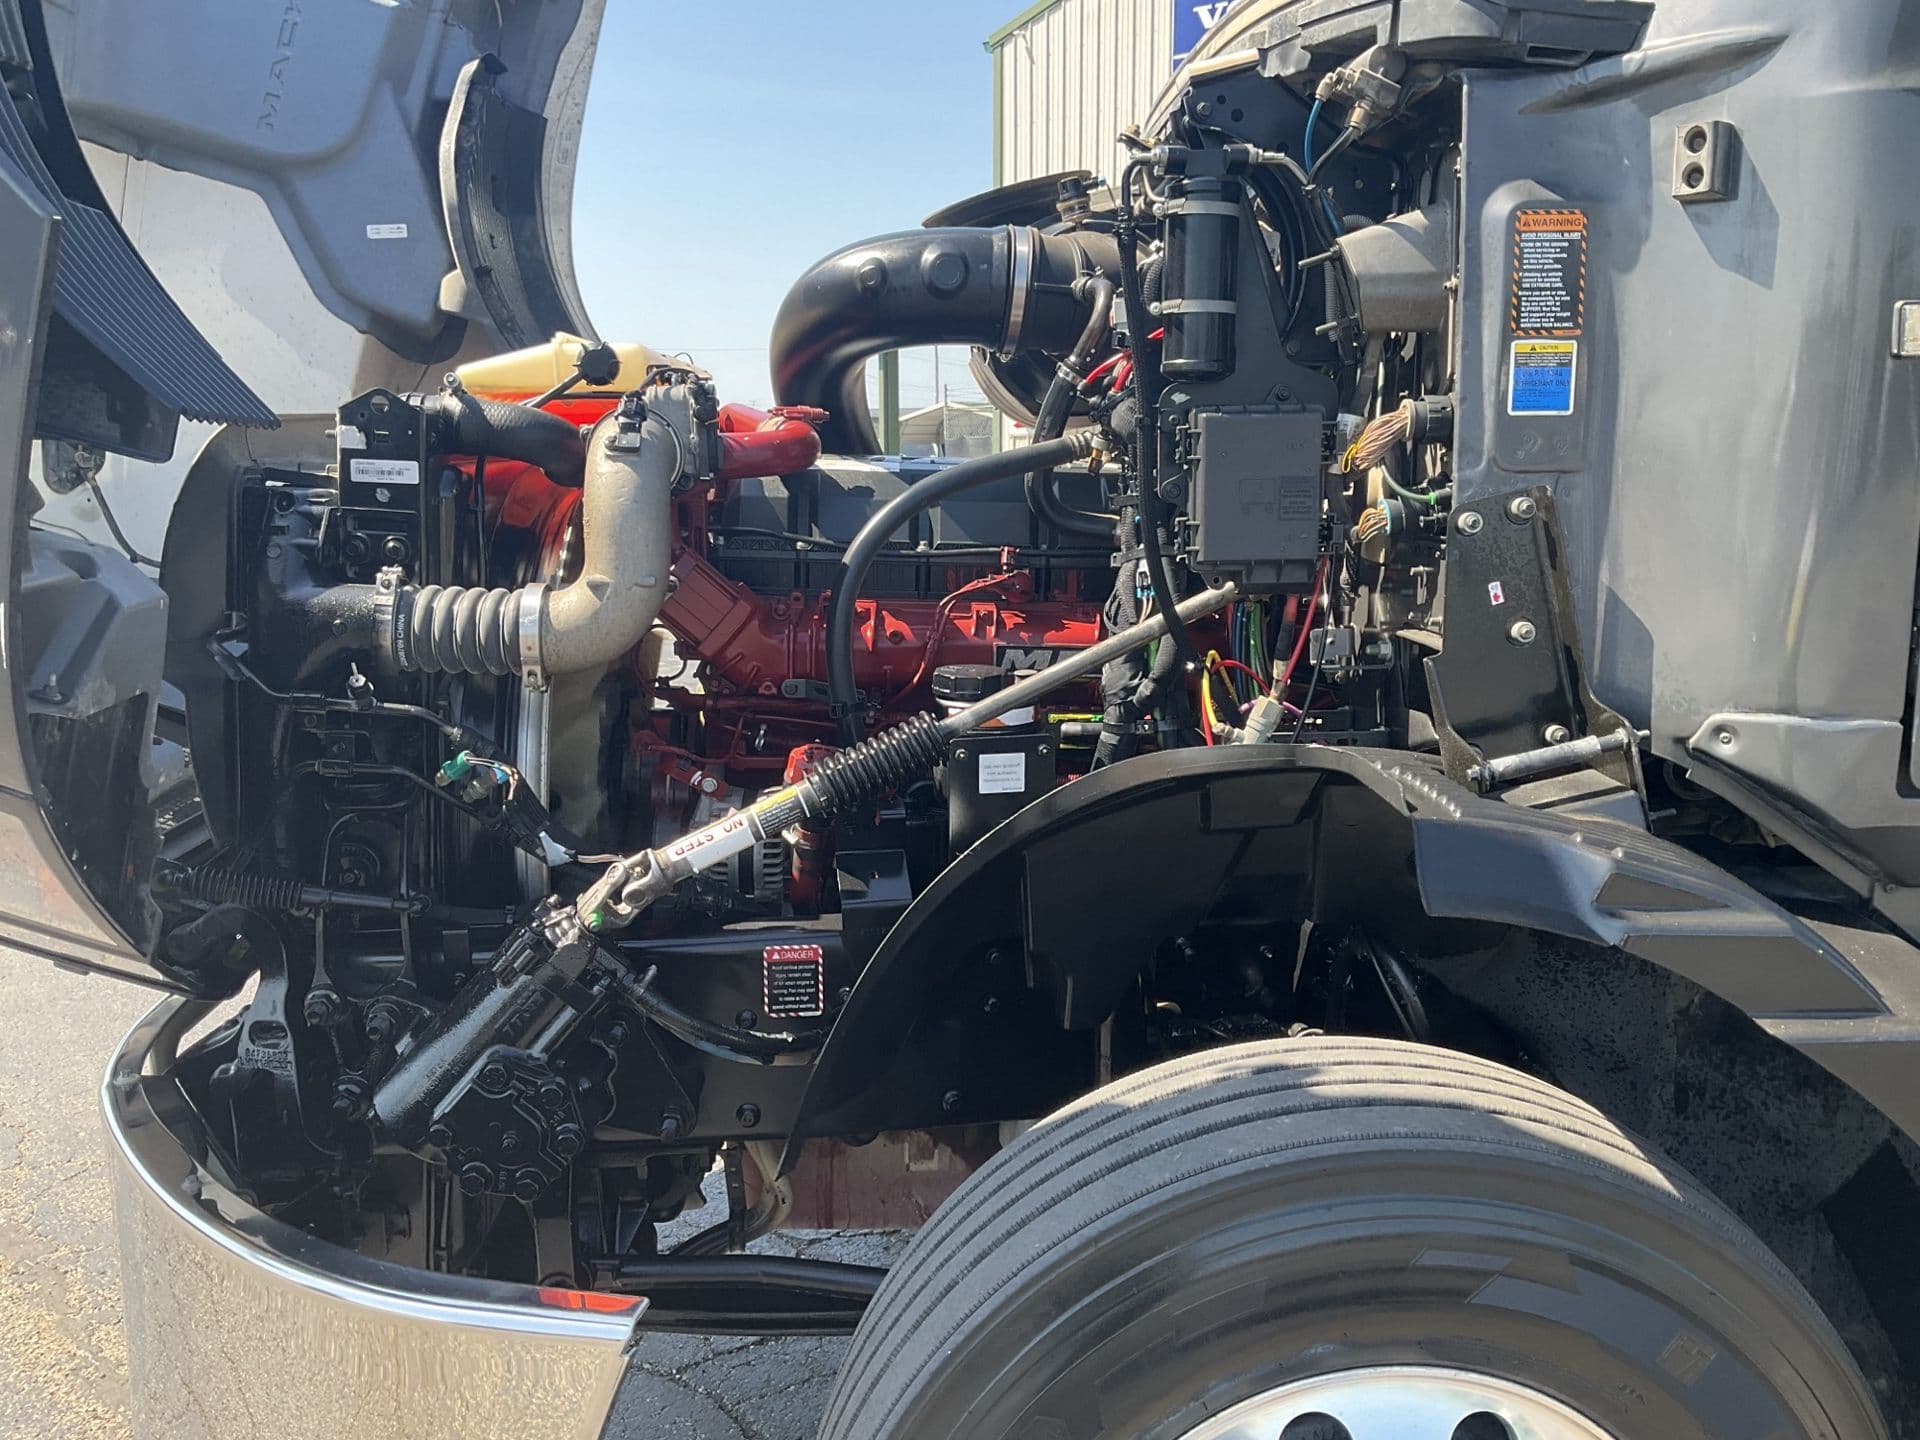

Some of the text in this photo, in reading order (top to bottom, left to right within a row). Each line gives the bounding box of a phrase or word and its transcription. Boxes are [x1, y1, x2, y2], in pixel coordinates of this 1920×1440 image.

[1532, 218, 1582, 227] WARNING
[396, 614, 406, 639] CHINA
[723, 819, 744, 833] NO
[780, 950, 814, 959] DANGER
